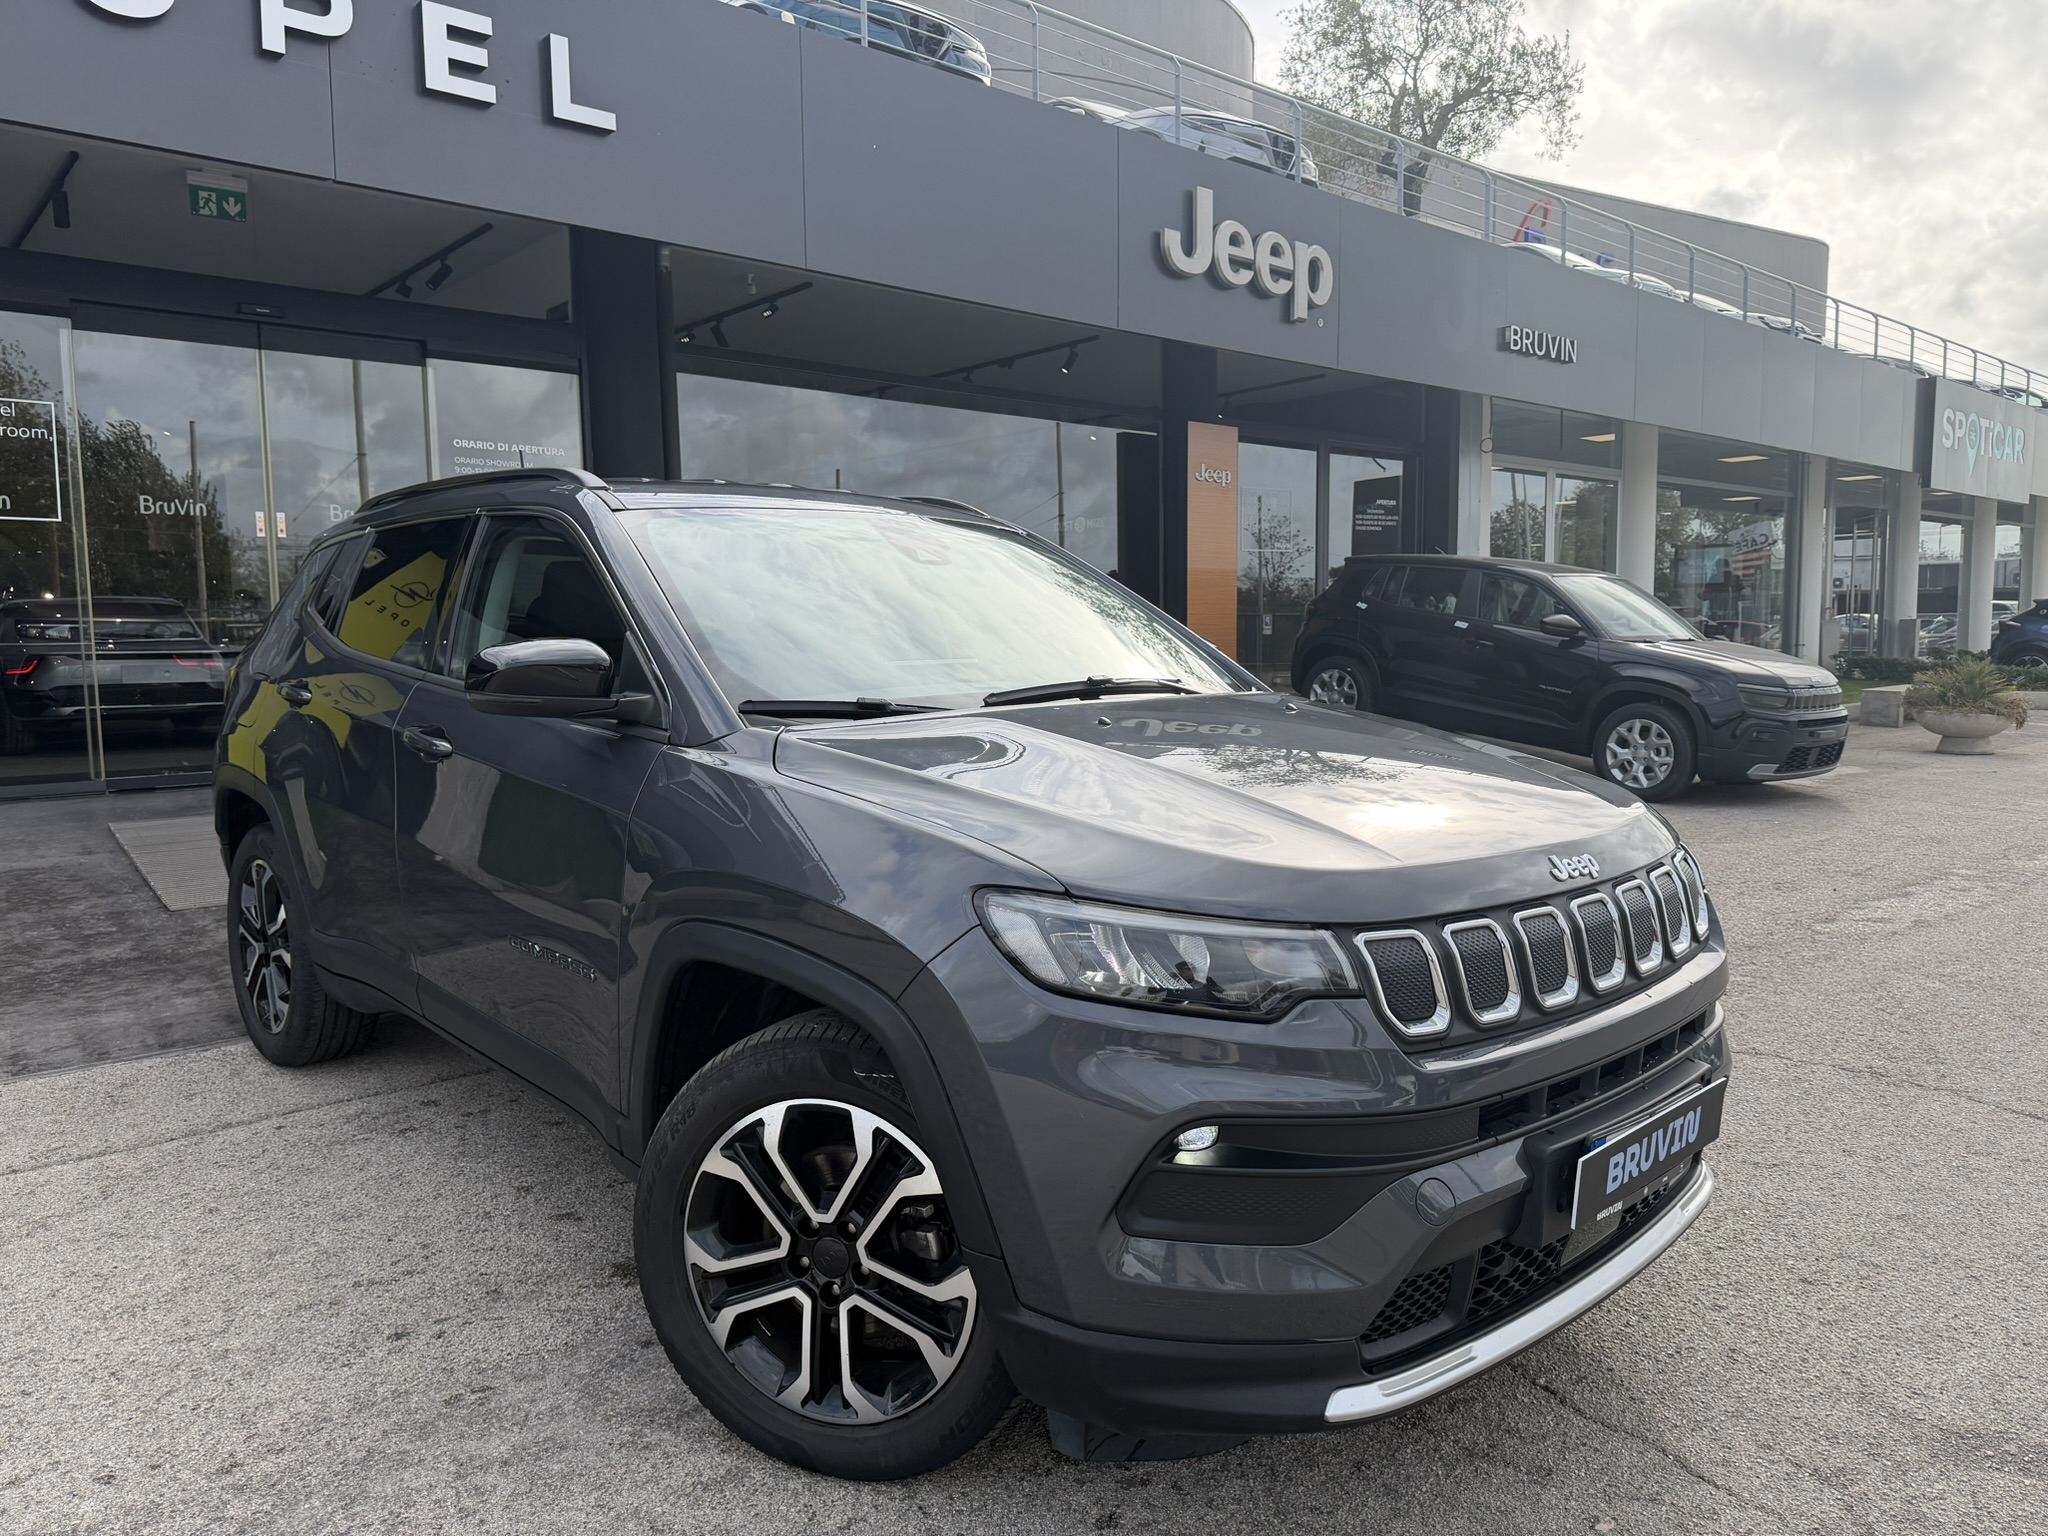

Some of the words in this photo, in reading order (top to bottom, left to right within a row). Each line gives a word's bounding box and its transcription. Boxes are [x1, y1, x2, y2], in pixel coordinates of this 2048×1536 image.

[90, 0, 617, 132] PEL
[1160, 185, 1333, 323] Jeep
[1509, 324, 1578, 363] BRUVIN
[453, 439, 495, 450] ORARIO
[497, 443, 509, 452] DI
[511, 444, 565, 456] APERTURA
[454, 456, 485, 466] ORARIO
[1195, 463, 1232, 487] Jeep
[139, 495, 207, 517] BruVin
[329, 504, 354, 521] Br
[1549, 853, 1600, 882] Jeep
[1606, 1105, 1702, 1195] BRUVIN
[1596, 1200, 1624, 1221] BRUVIN
